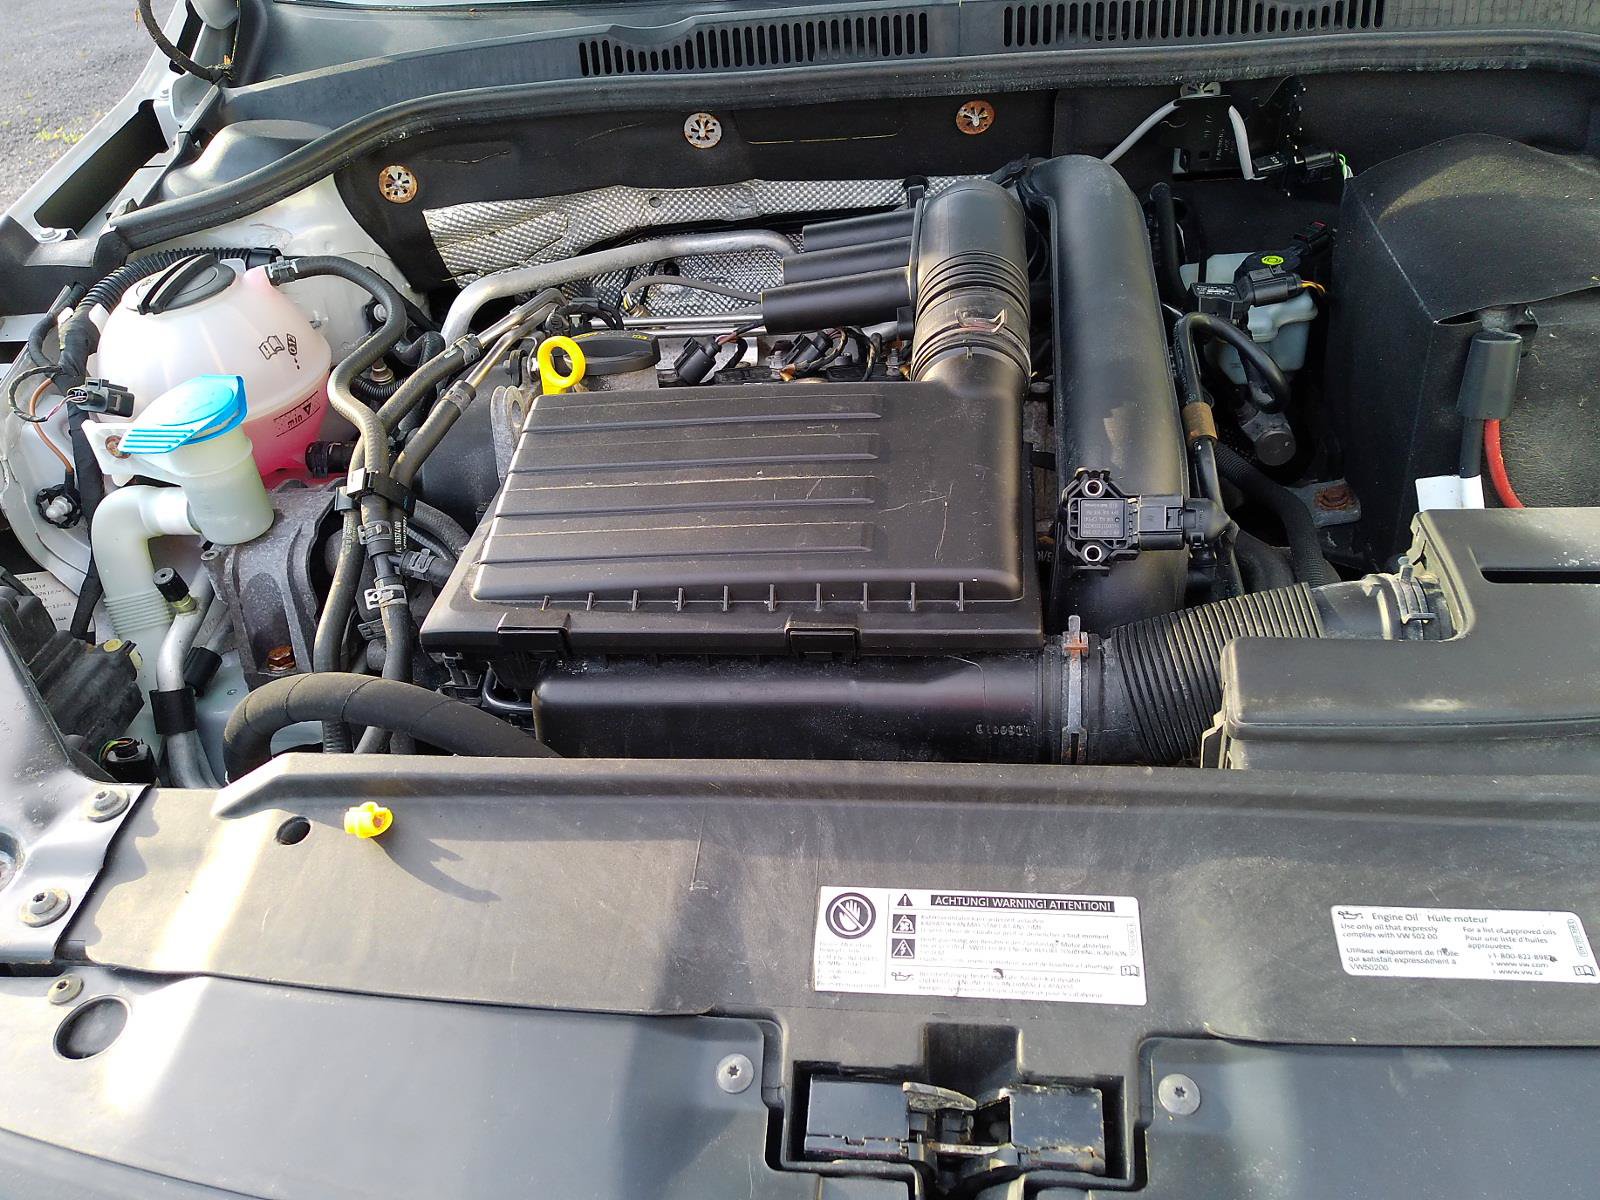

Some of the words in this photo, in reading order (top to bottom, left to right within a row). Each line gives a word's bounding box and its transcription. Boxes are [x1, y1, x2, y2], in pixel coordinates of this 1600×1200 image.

[287, 413, 303, 428] min
[935, 896, 989, 906] ACHTUNG!
[992, 898, 1047, 909] WARNING!
[1049, 900, 1111, 911] ATTENTION!
[1372, 912, 1404, 922] Engine
[1405, 913, 1419, 921] Oil
[1427, 914, 1452, 923] Huile
[1356, 923, 1372, 931] only
[1403, 925, 1438, 933] expressly
[1342, 931, 1376, 939] complies
[1465, 934, 1482, 942] Pour
[1376, 948, 1423, 957] uniquement
